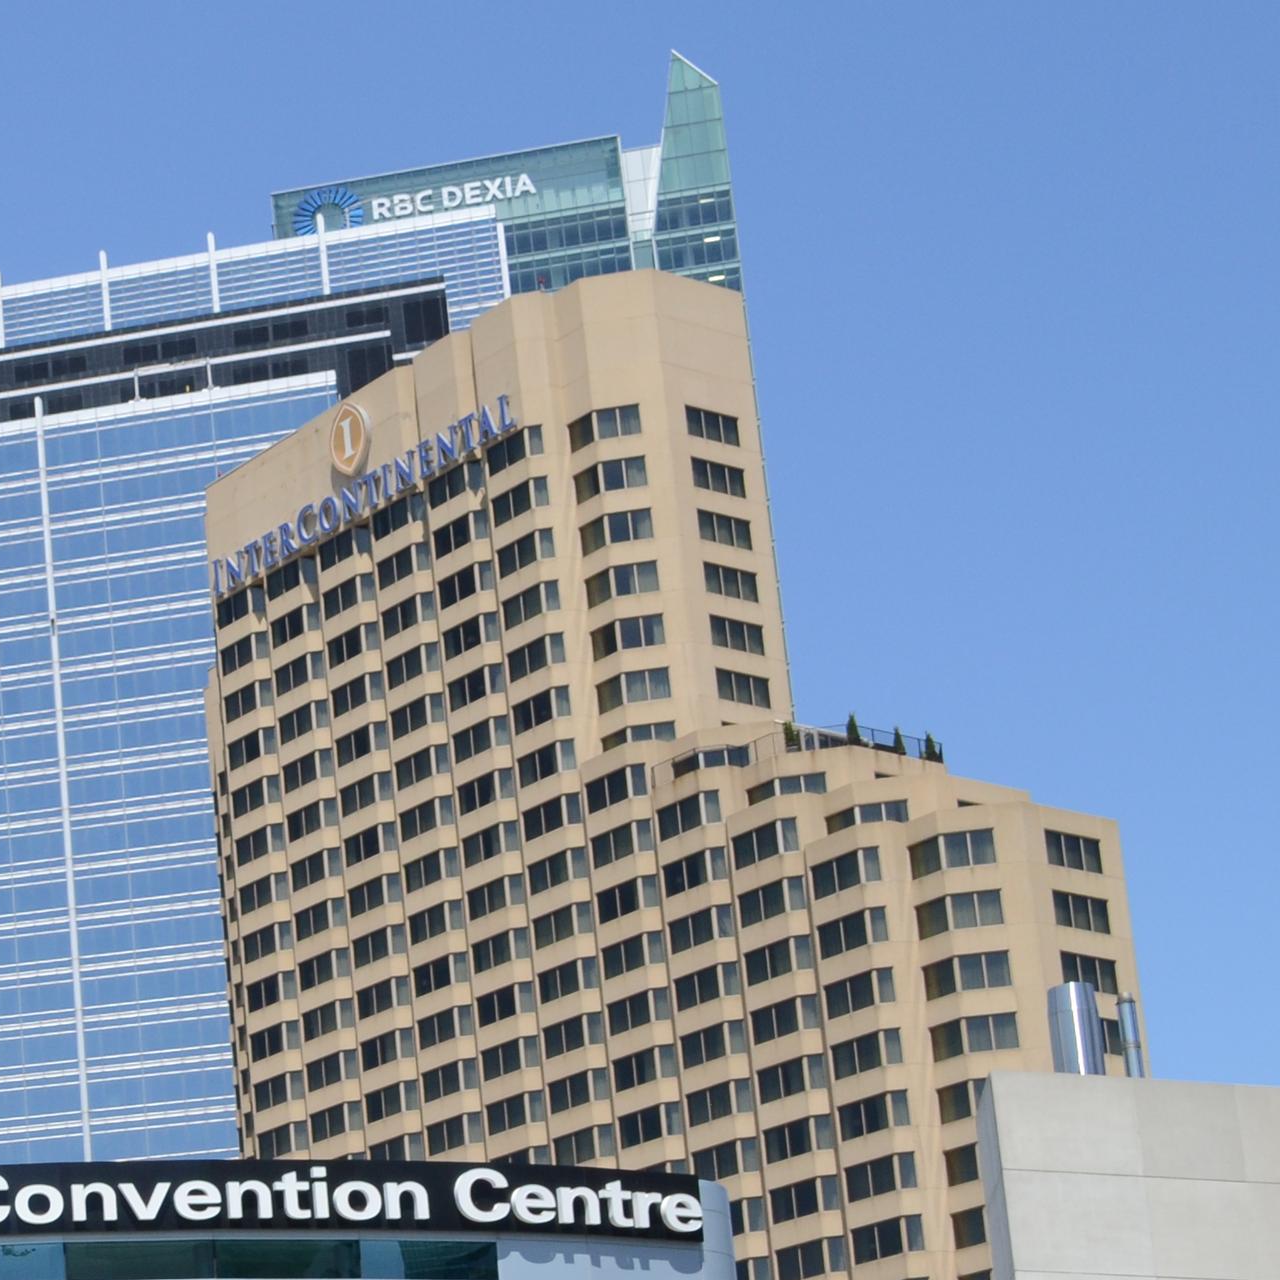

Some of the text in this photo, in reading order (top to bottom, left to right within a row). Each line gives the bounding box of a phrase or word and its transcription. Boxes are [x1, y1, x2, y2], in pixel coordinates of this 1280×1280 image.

[371, 173, 537, 221] RBC DEXIA
[212, 394, 518, 597] INTERCONTINENTAL
[453, 1167, 704, 1235] Centre
